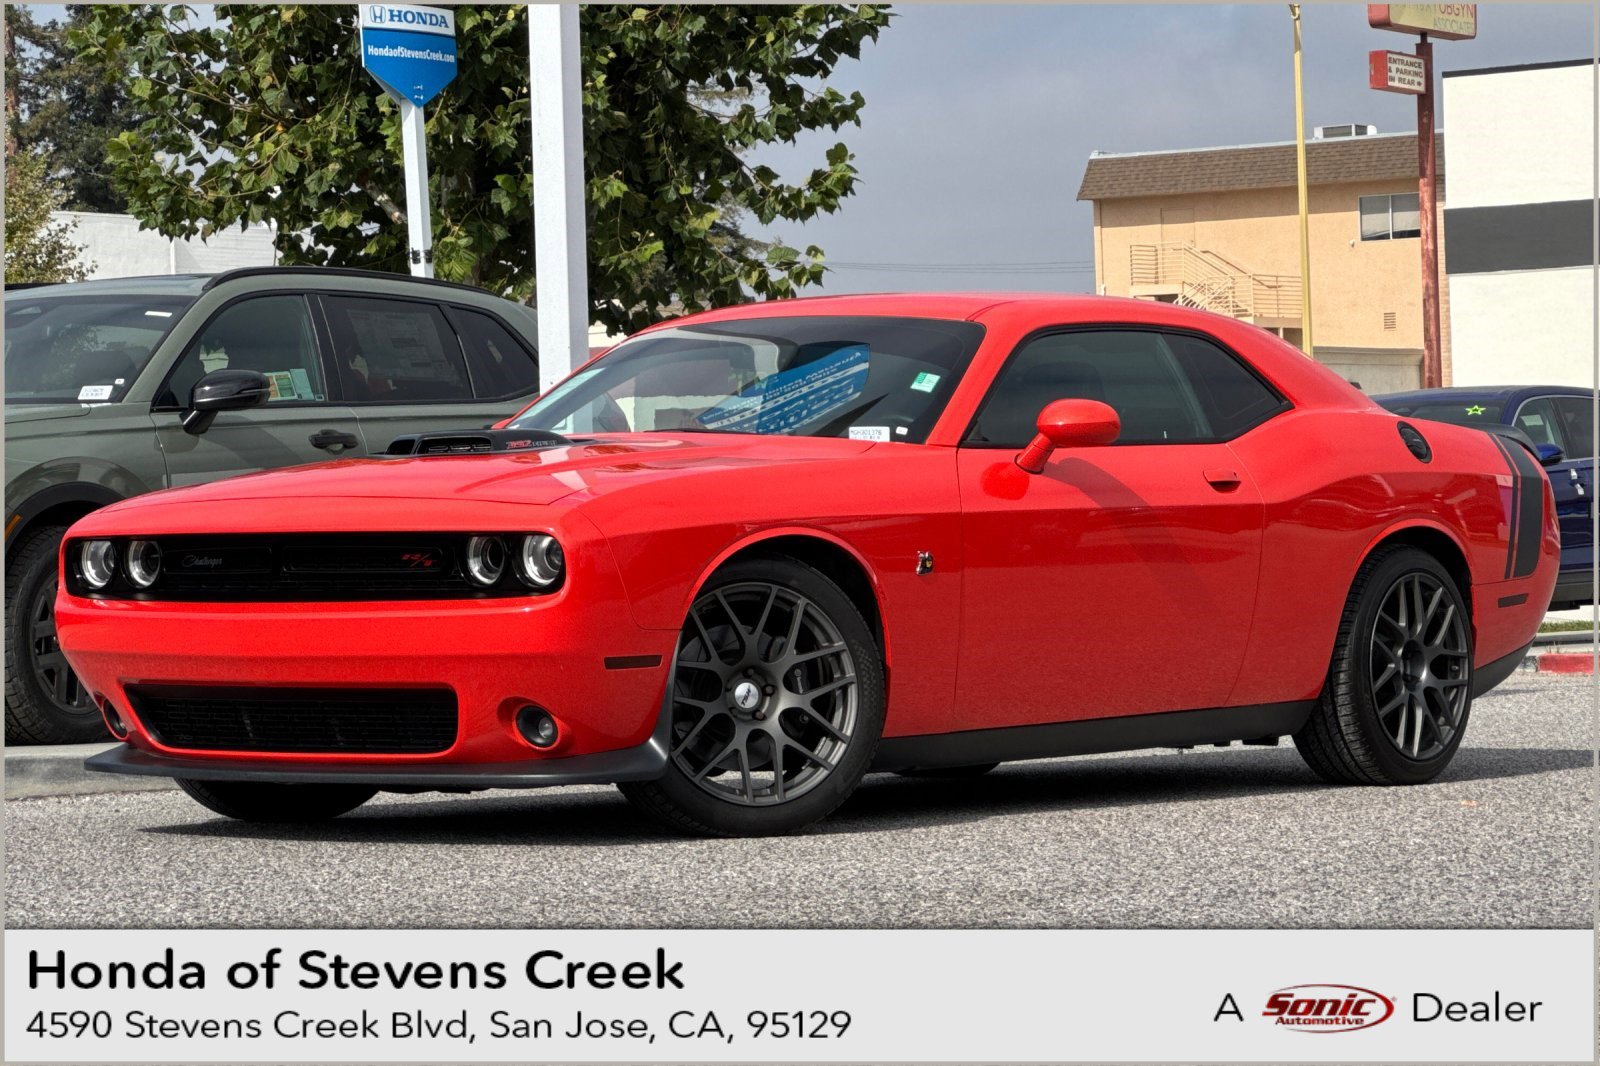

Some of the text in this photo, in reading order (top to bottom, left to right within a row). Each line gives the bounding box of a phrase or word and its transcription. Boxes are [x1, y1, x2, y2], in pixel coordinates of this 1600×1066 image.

[388, 9, 449, 28] HONDA
[368, 44, 455, 63] HondaofStevensCreek.com
[1388, 56, 1422, 69] ENTRANCE
[1395, 67, 1423, 78] PARKING
[1397, 76, 1415, 87] REAR
[182, 555, 223, 568] Challenger
